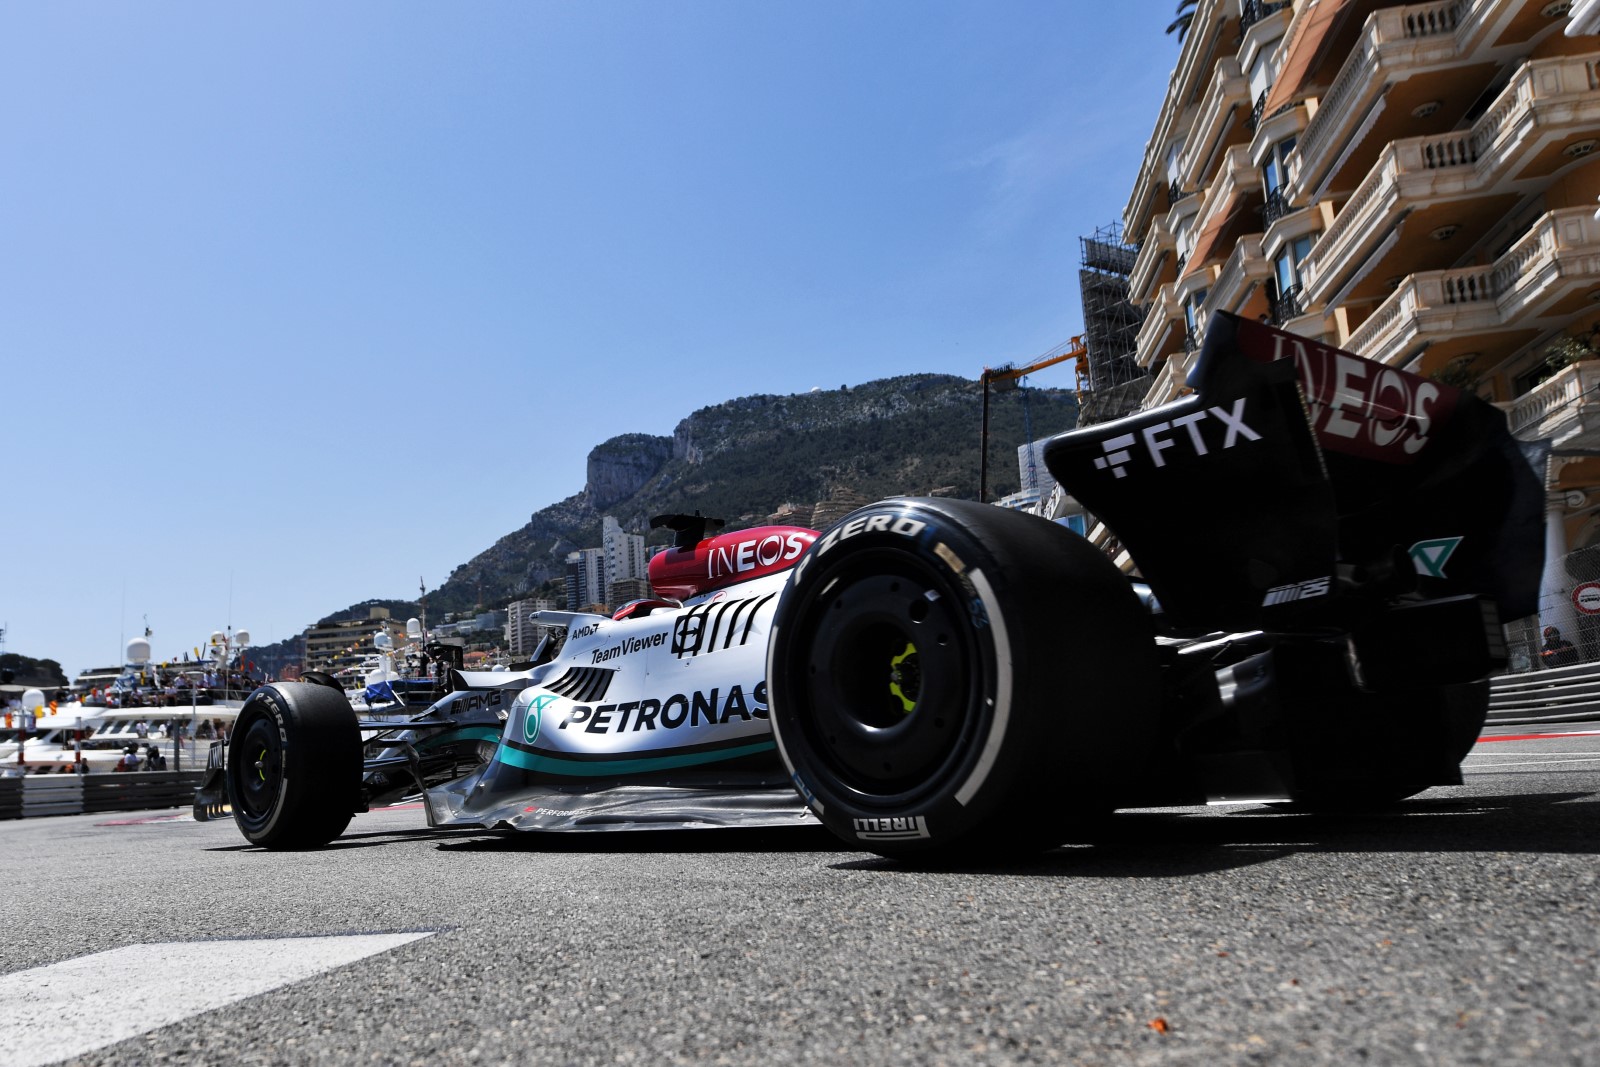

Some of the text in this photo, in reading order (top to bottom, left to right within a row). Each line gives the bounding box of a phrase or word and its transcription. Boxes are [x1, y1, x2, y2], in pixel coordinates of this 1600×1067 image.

[1140, 396, 1264, 470] FTX
[707, 531, 804, 579] INEOS
[816, 514, 927, 559] ZERO
[591, 632, 668, 665] TeamViewer
[255, 692, 288, 742] P ZERO
[467, 689, 501, 712] AMG
[559, 680, 768, 734] PETRONAS
[853, 814, 931, 842] PIRELLI
